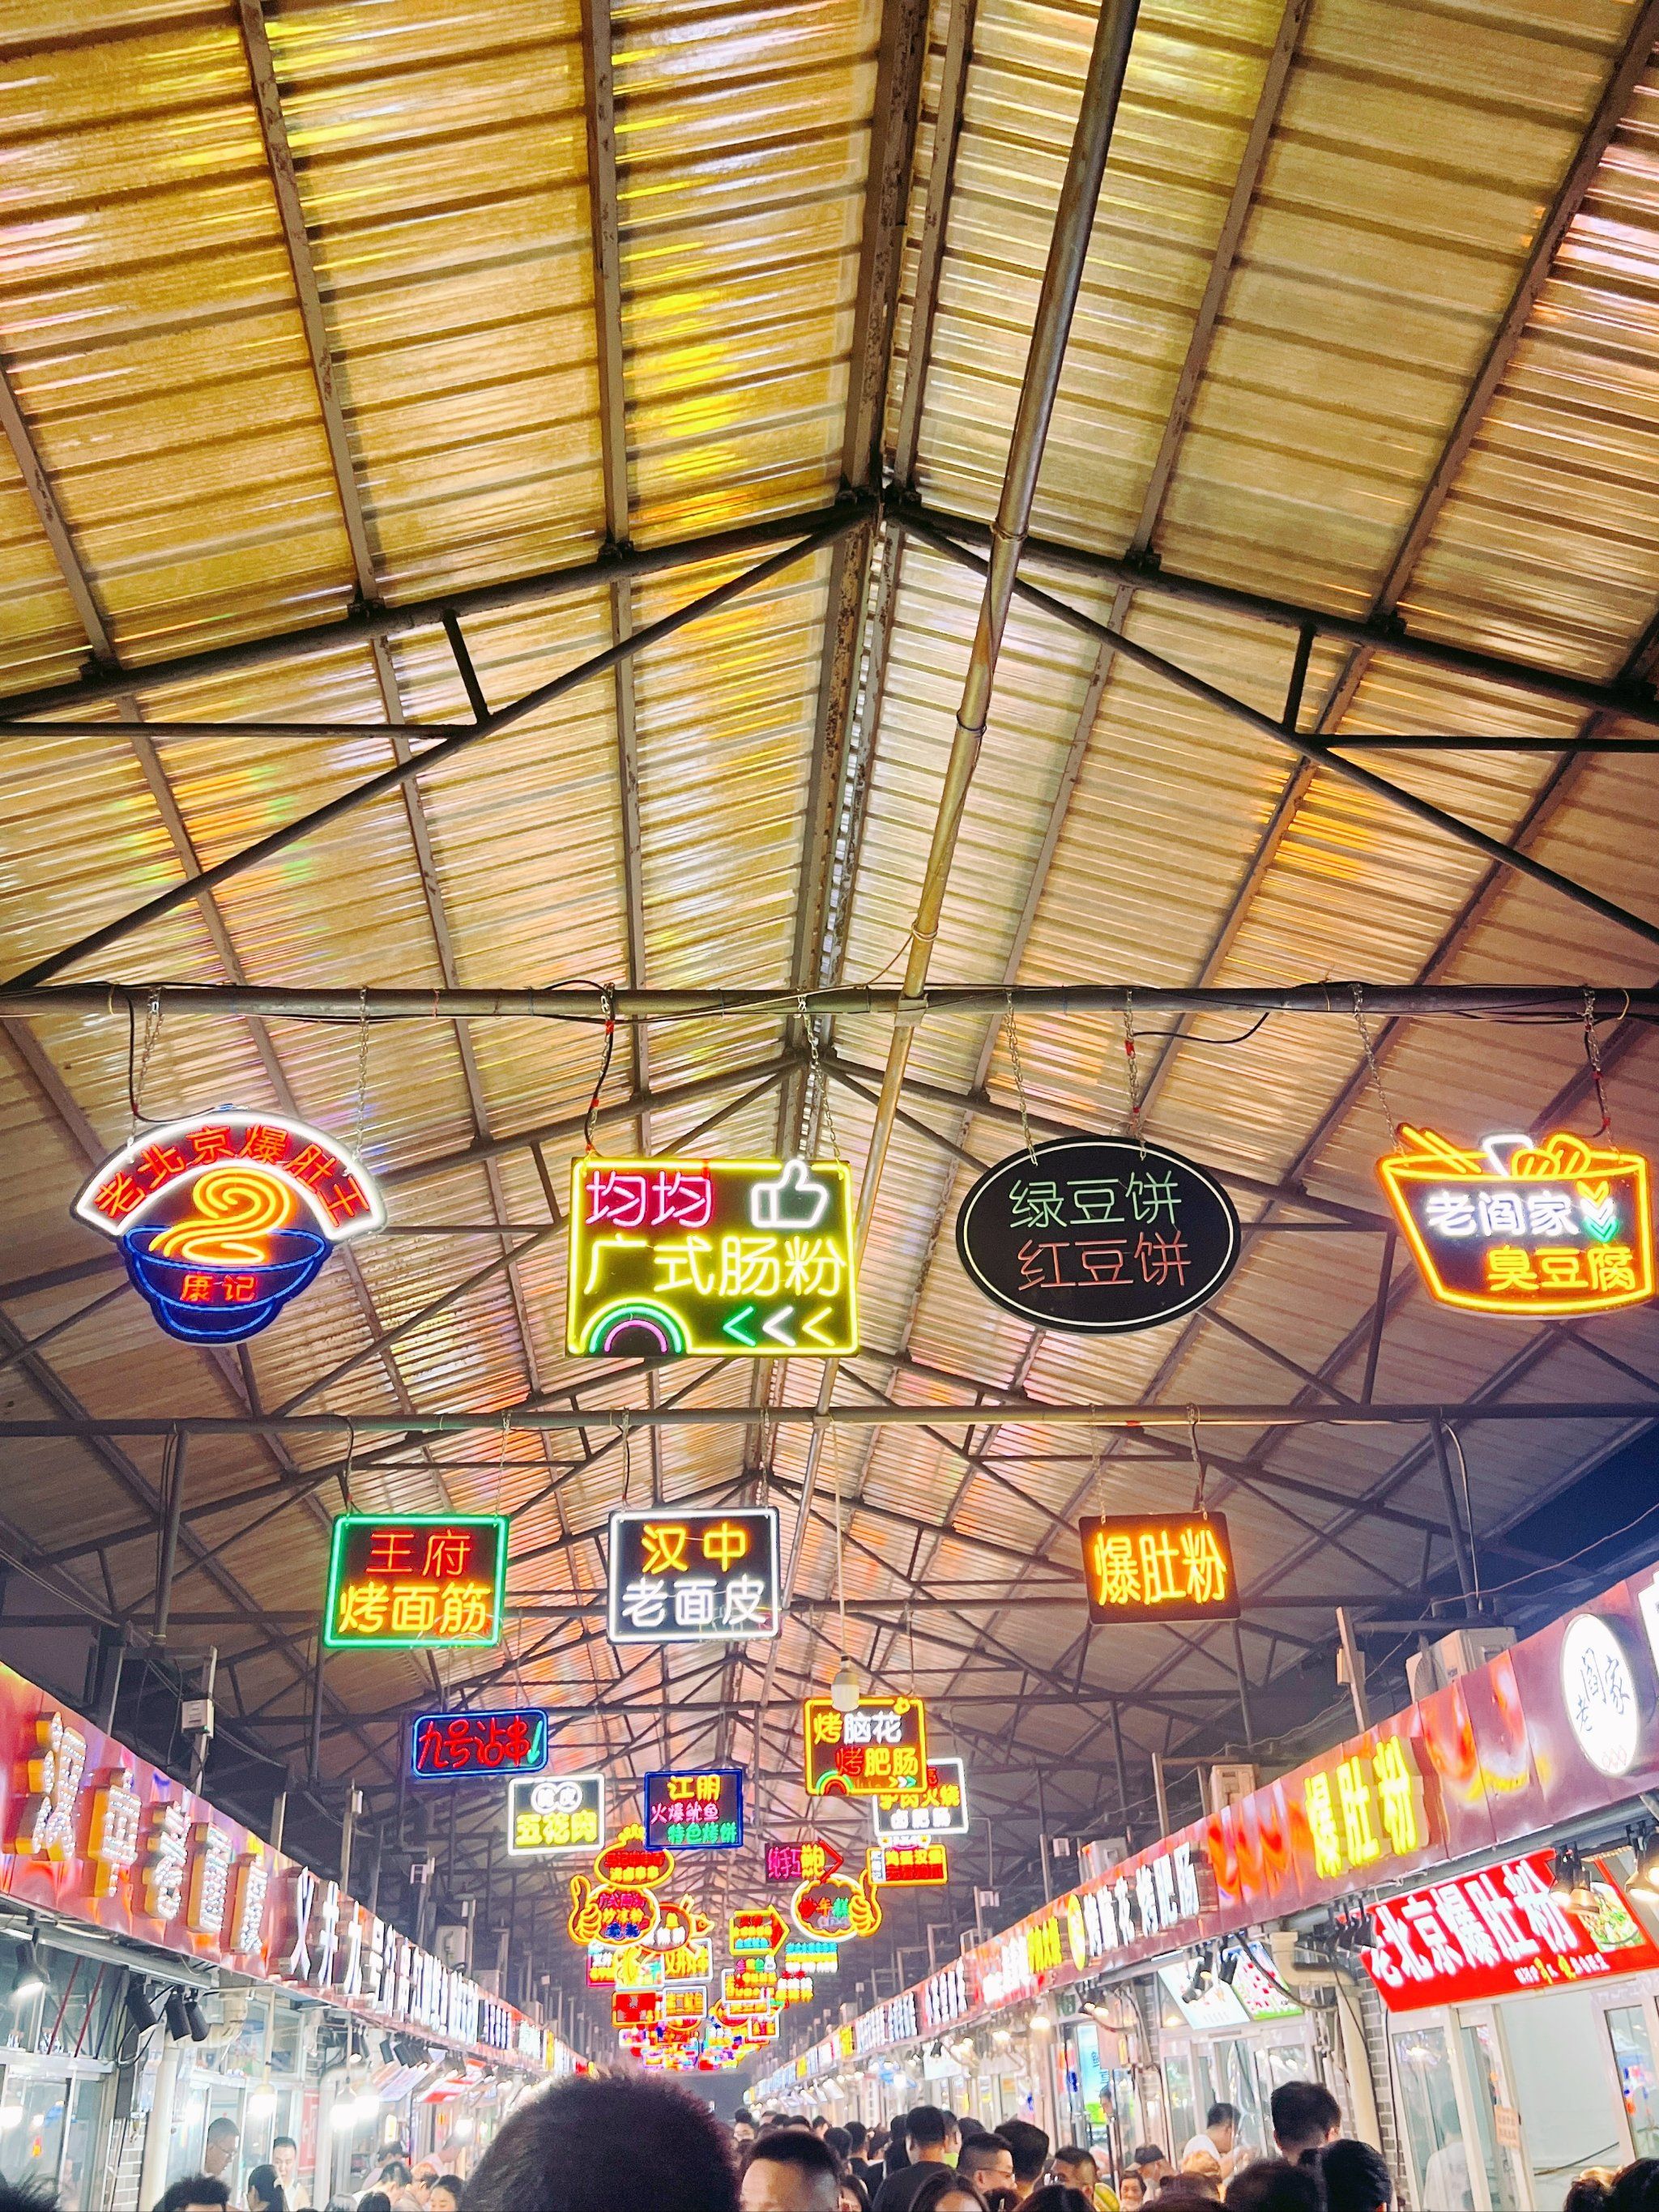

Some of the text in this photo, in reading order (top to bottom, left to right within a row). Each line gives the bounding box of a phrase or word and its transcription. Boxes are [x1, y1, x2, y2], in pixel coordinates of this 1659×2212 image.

[93, 1124, 371, 1228] 老北京爆肚王
[586, 1170, 712, 1228] 均均
[1009, 1170, 1182, 1228] 绿豆饼
[180, 1272, 257, 1302] 康记
[584, 1234, 847, 1296] 广式肠粉
[1017, 1231, 1191, 1290] 红豆饼
[1486, 1245, 1636, 1292] 臭豆腐
[366, 1528, 471, 1577] 王府
[641, 1521, 746, 1575] 汉中
[1094, 1528, 1227, 1606] 爆肚粉
[339, 1581, 491, 1633] 烤面筋
[621, 1574, 766, 1627] 老面皮
[813, 1711, 902, 1745] 烤脑花
[836, 1747, 919, 1777] 烤肥肠
[515, 1809, 598, 1846] 五花肉
[1304, 1735, 1418, 1879] 爆肚粉
